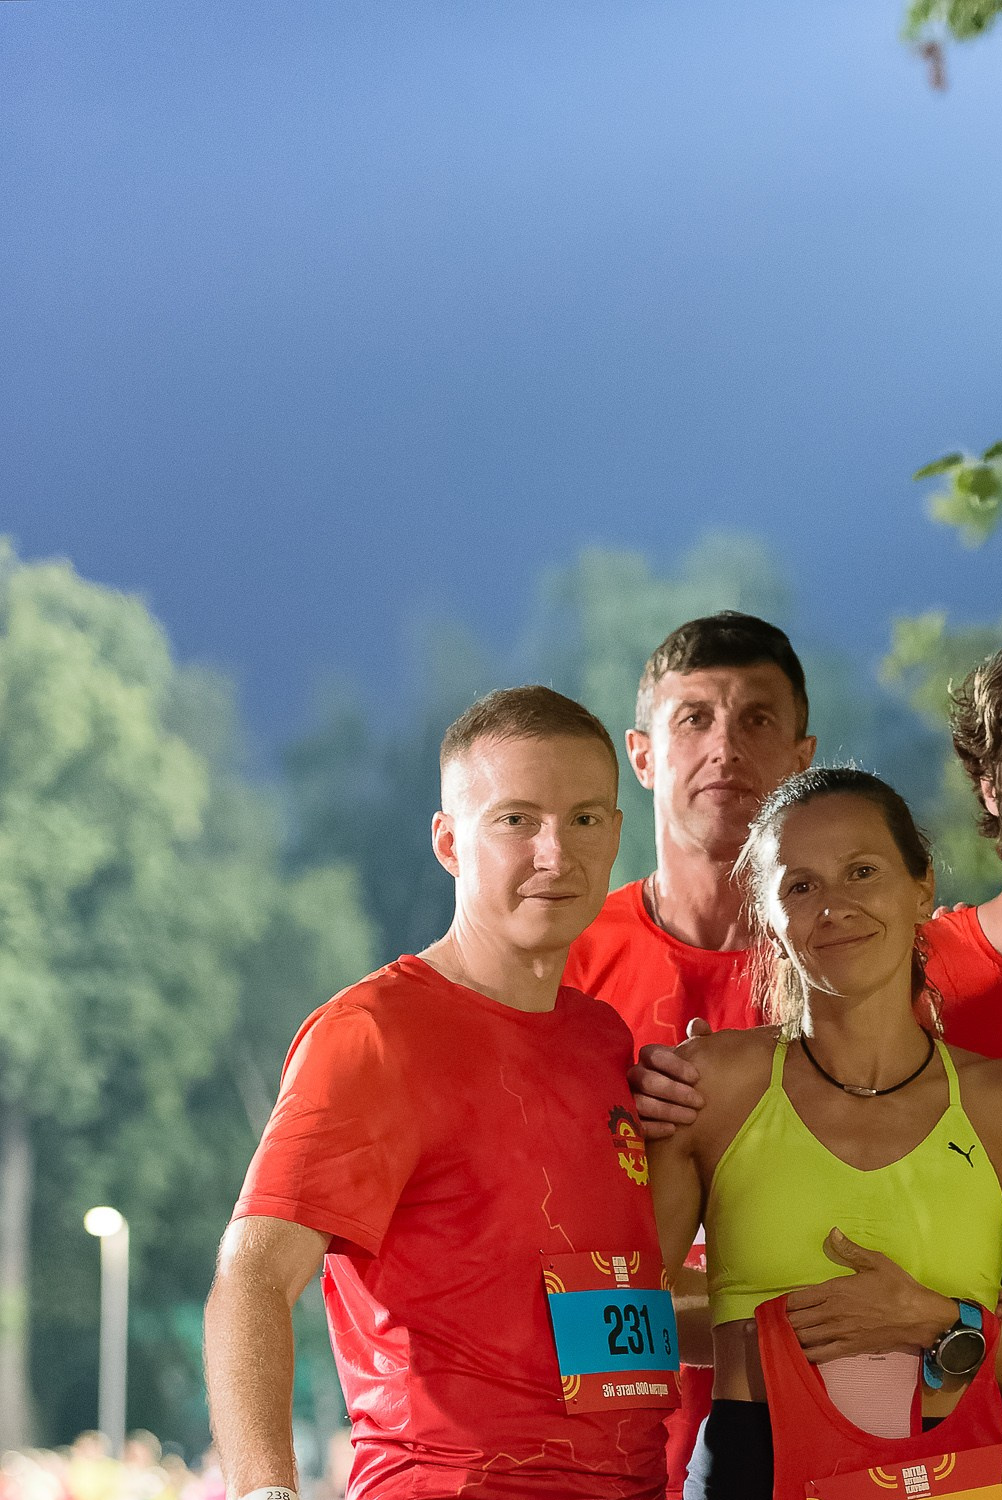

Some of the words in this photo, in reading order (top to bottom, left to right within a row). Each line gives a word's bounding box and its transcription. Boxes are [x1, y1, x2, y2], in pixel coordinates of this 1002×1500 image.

[603, 1304, 655, 1356] 231
[662, 1328, 672, 1356] 3
[602, 1382, 615, 1398] 3й
[615, 1384, 636, 1397] этап
